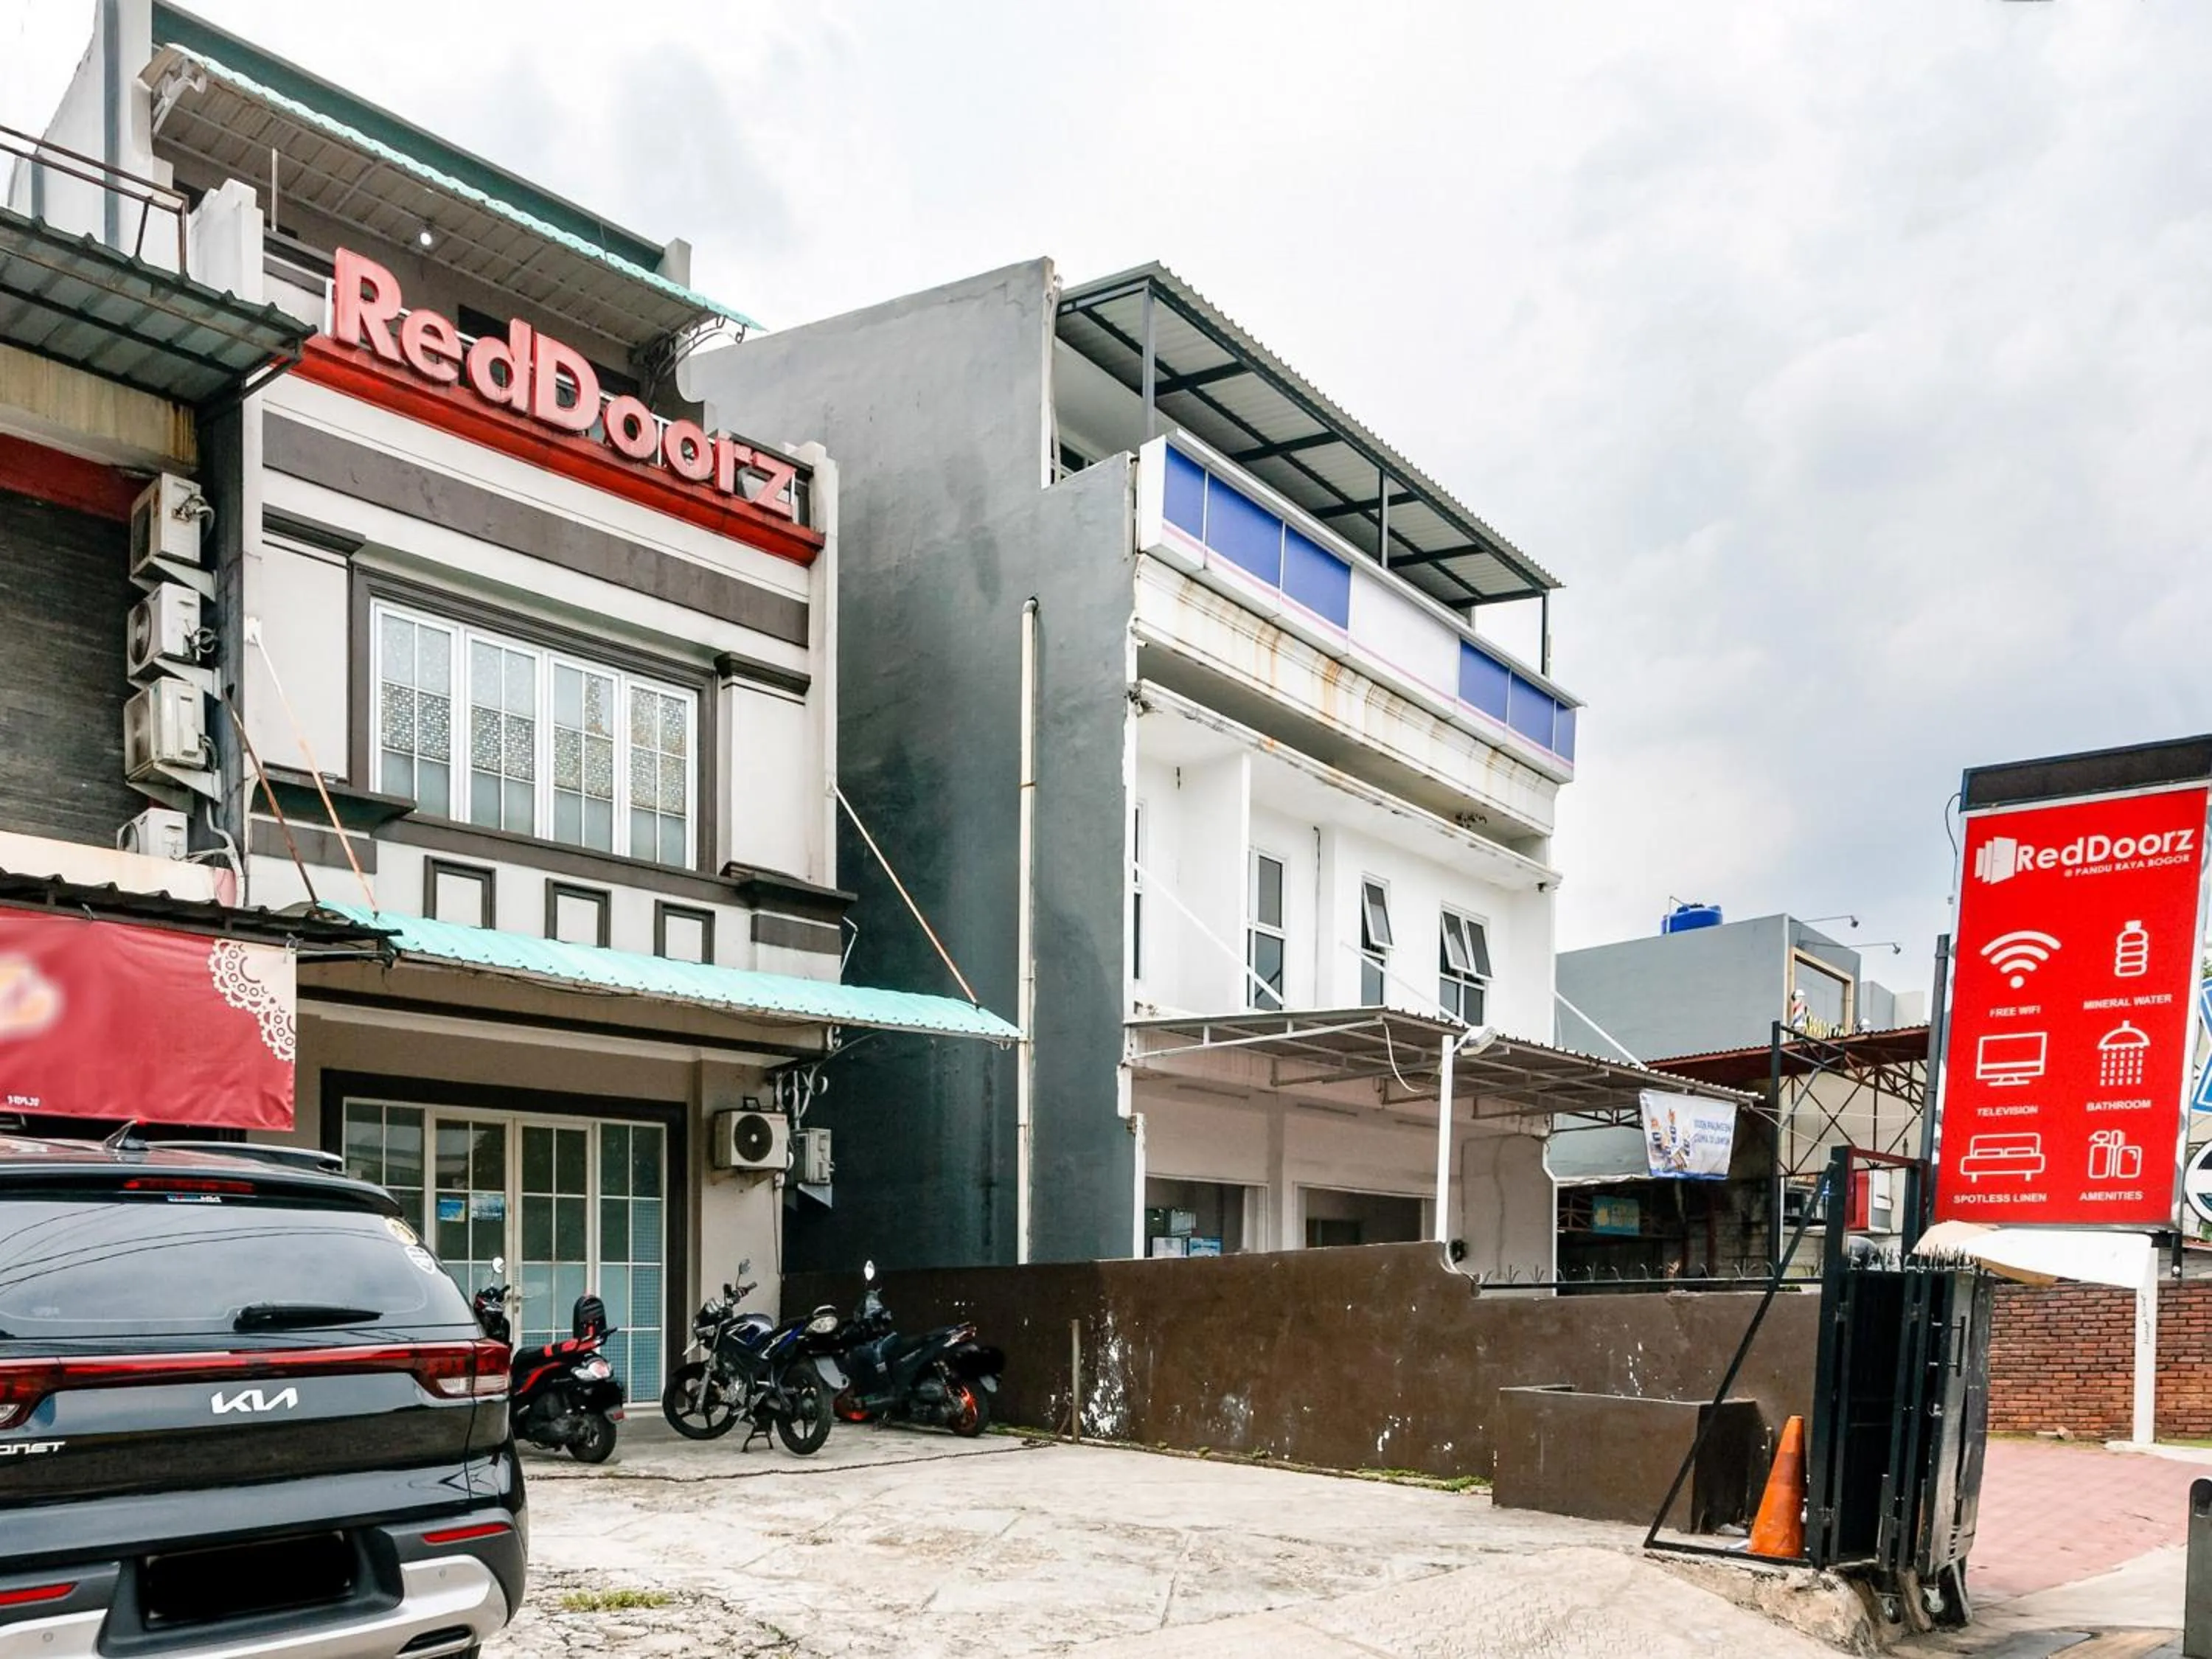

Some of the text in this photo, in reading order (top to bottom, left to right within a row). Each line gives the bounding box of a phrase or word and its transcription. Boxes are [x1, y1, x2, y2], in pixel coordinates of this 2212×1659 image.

[334, 246, 797, 520] RedDoorz
[2016, 828, 2194, 872] RedDoorz
[2075, 864, 2112, 877] PANDU
[2115, 860, 2145, 872] RAYA
[2147, 854, 2190, 868] BOGOR
[2083, 993, 2172, 1010] MINERAL WATER
[1989, 1005, 2041, 1017] FREE WIFI
[1977, 1105, 2039, 1117] TELEVISION
[2086, 1099, 2152, 1112] BATHROOM
[1952, 1192, 2048, 1205] SPOTLESS LINEN
[2079, 1190, 2143, 1202] AMENITIES
